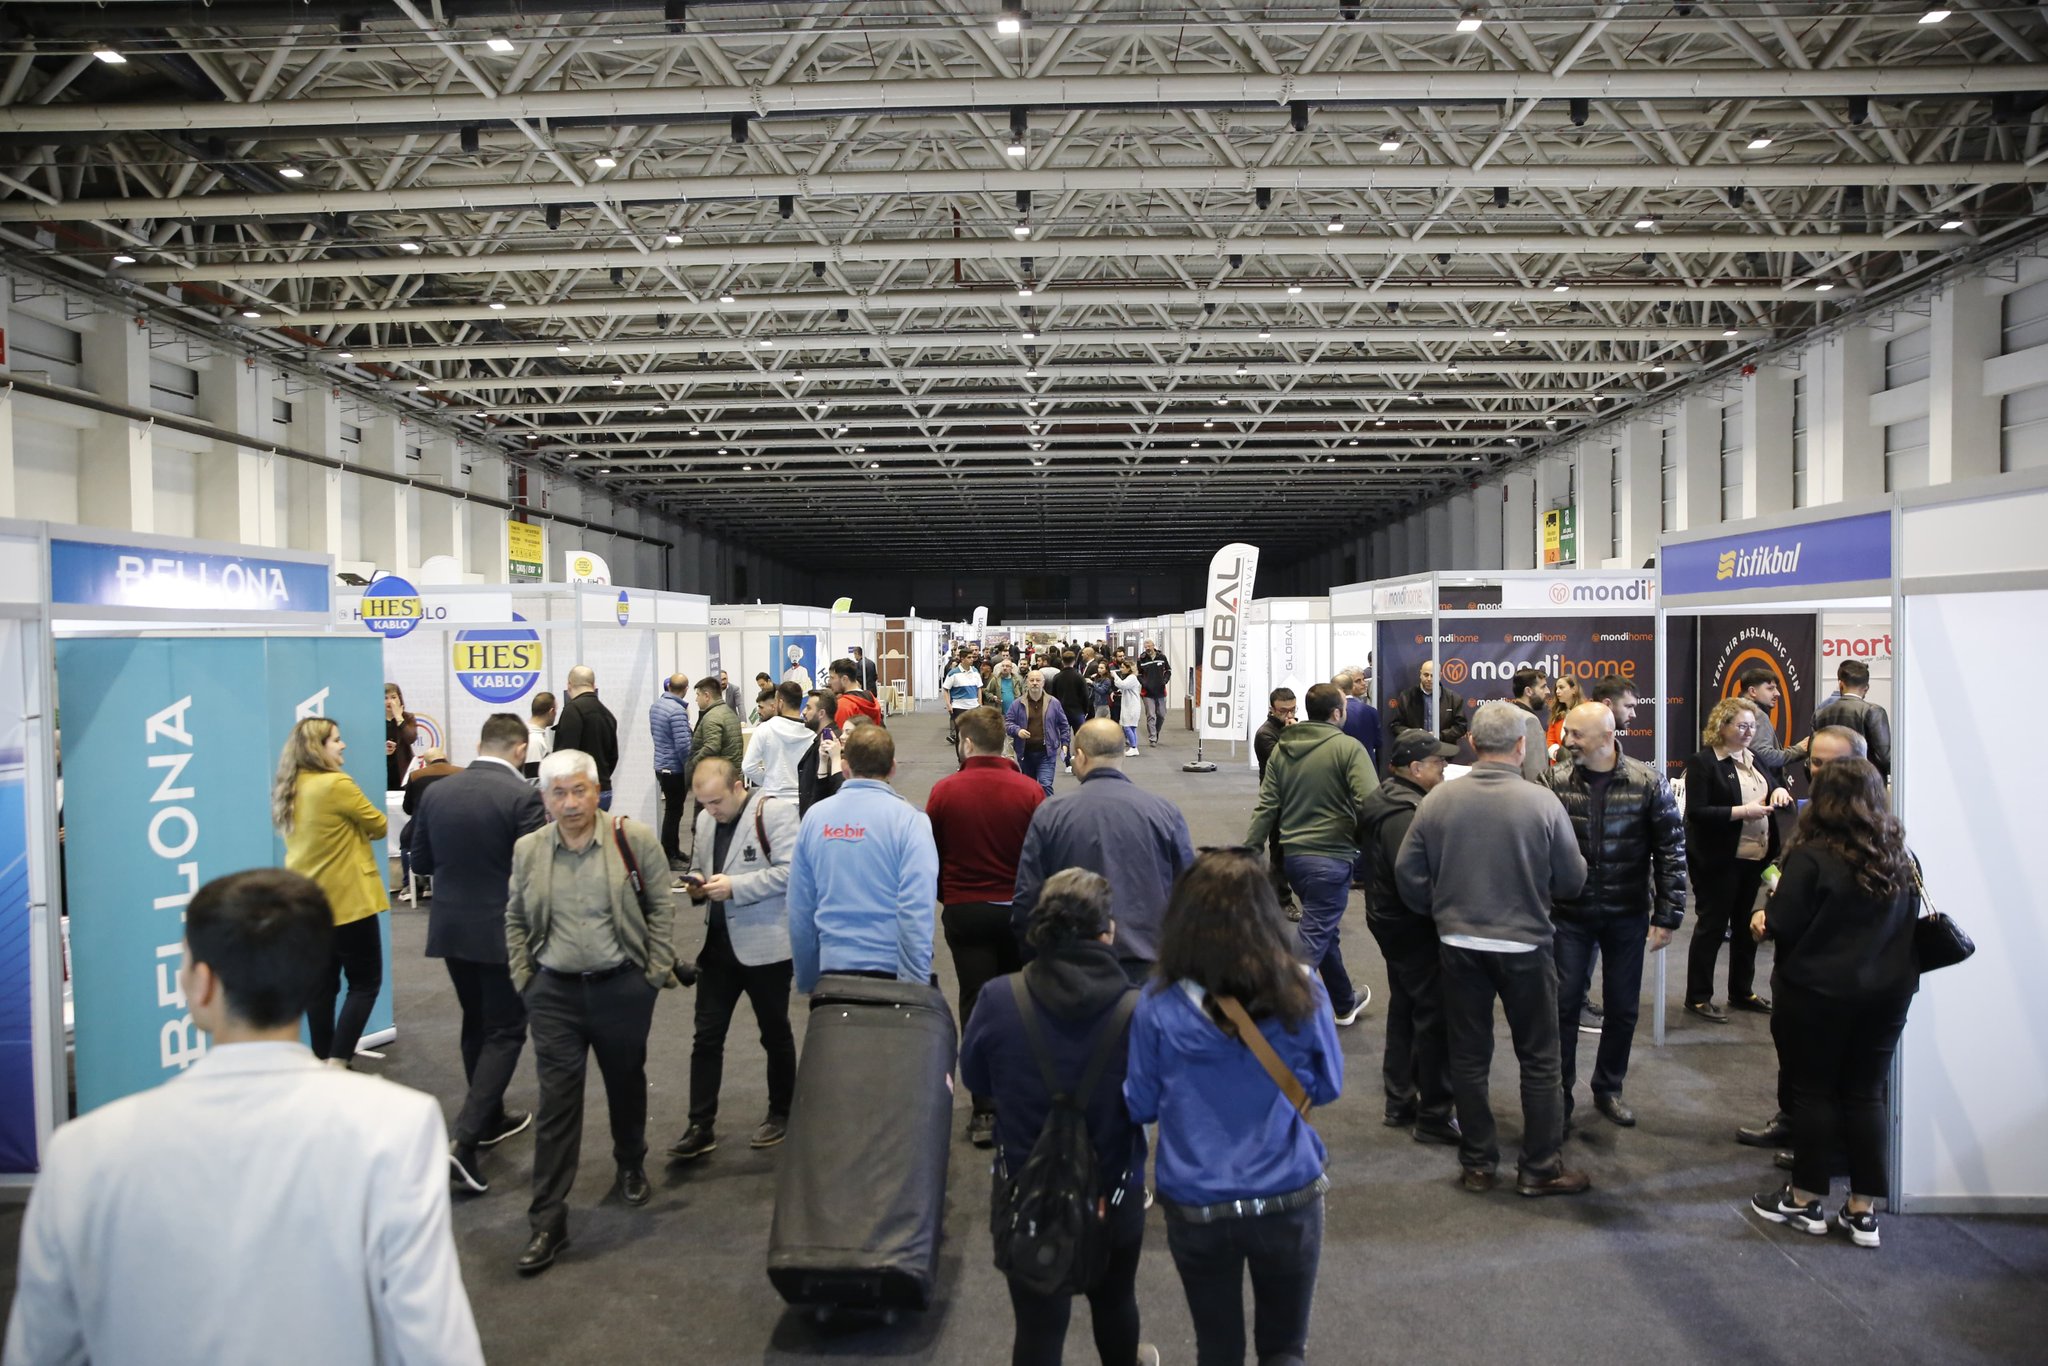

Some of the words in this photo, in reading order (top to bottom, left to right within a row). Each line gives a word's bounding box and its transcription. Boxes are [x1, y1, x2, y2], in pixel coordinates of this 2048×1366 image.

[1736, 542, 1801, 577] istikbal
[370, 599, 413, 616] HES
[374, 620, 410, 629] KABLO
[1208, 557, 1241, 729] GLOBAL
[1424, 633, 1479, 643] mndihome
[1513, 633, 1567, 642] mondihome
[1600, 632, 1653, 641] mondihome
[468, 644, 530, 669] HES
[473, 675, 525, 689] KABLO
[823, 823, 866, 837] kebir
